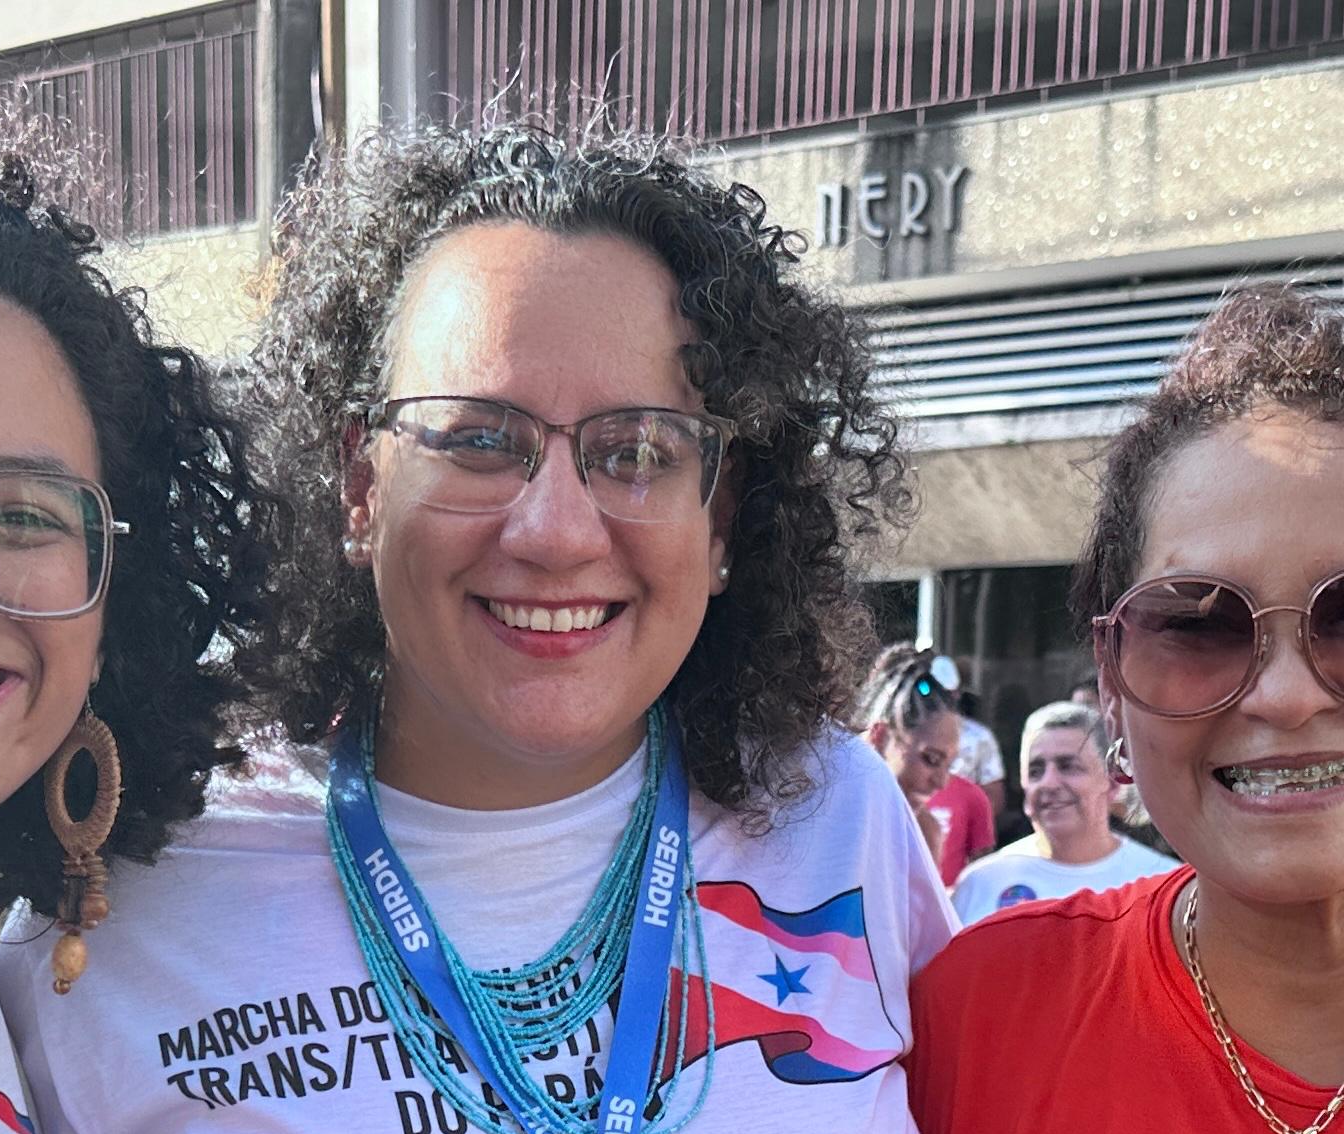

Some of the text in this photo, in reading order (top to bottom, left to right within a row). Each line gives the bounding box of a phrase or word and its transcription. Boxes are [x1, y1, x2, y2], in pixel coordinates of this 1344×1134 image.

[364, 846, 430, 953] SEIRDH
[643, 825, 681, 929] SEIRDH
[158, 992, 326, 1067] MARCHA
[330, 980, 389, 1029] DO
